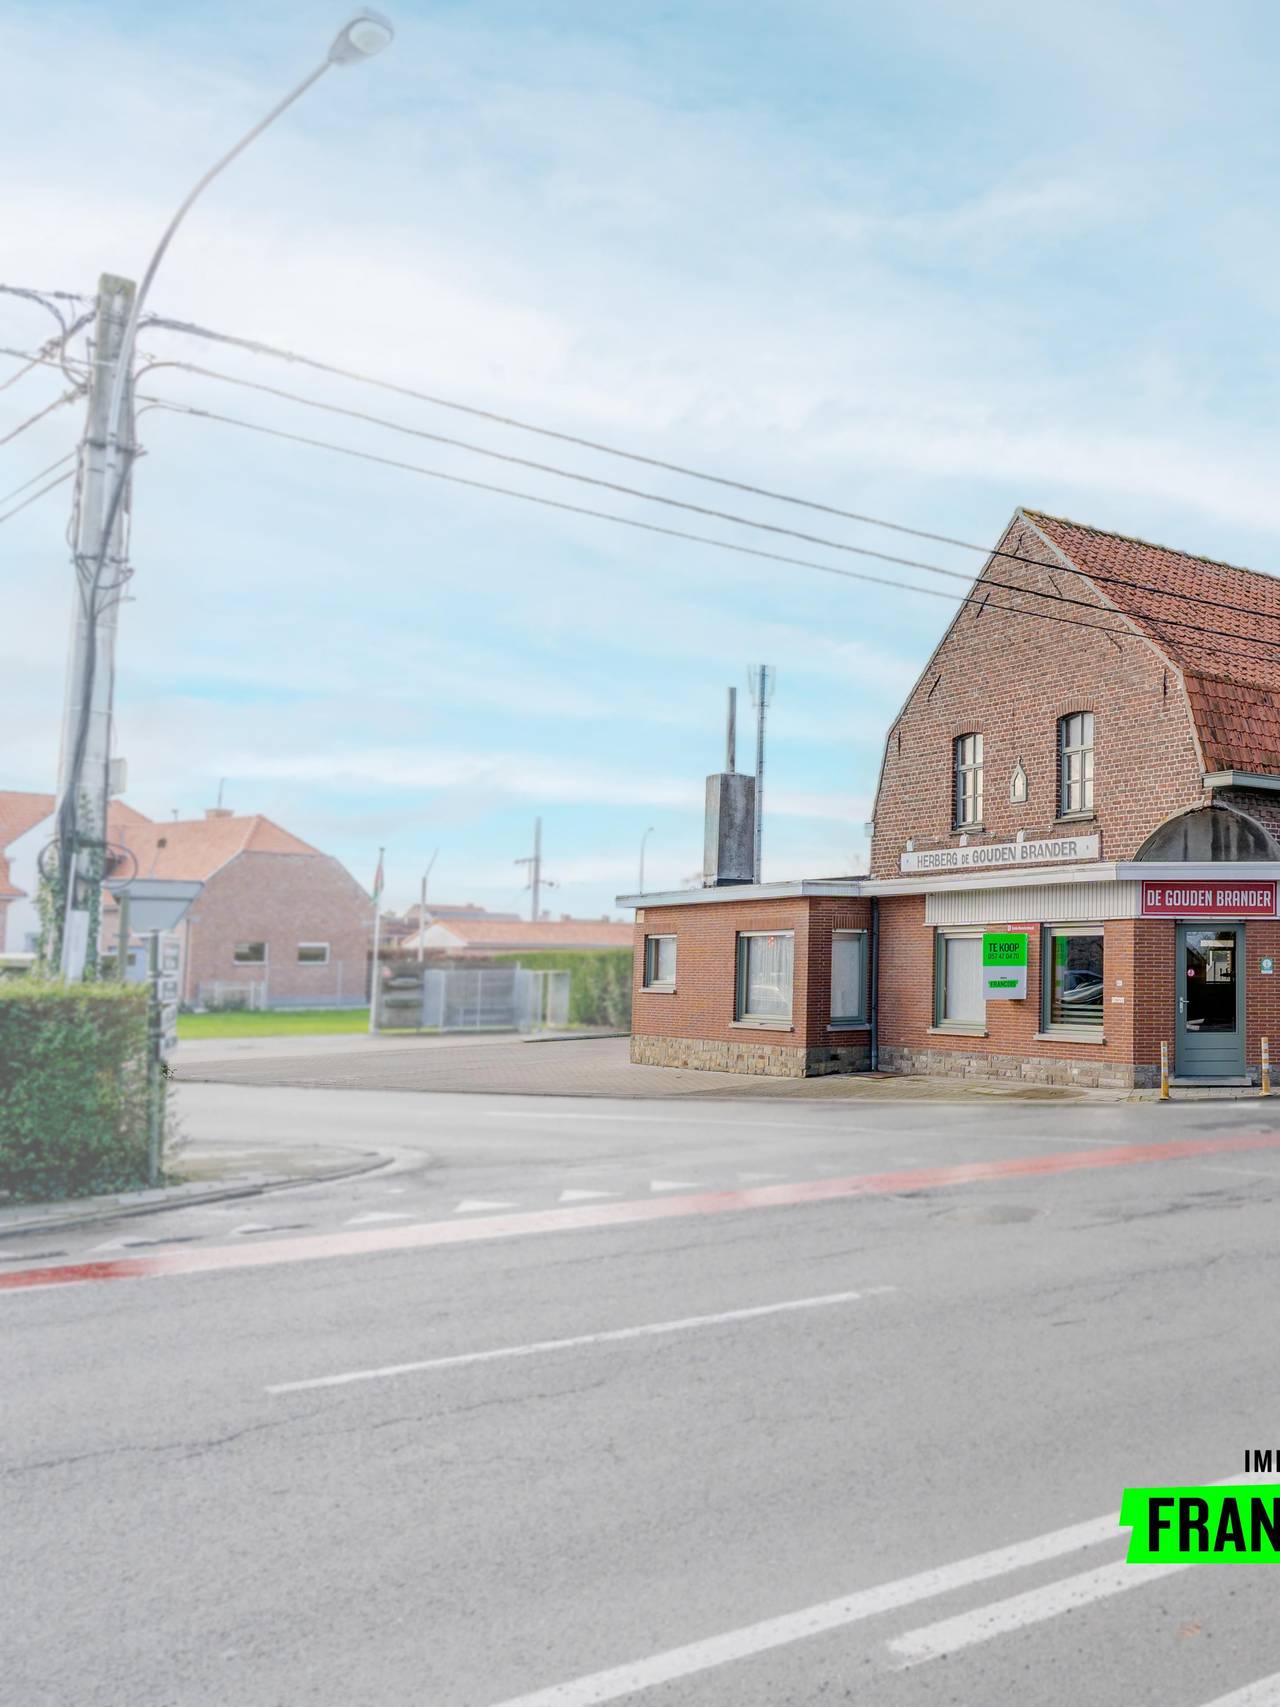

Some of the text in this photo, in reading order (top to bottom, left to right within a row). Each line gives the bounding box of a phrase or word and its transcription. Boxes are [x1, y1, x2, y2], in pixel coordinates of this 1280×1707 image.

[917, 841, 1077, 869] HERBERG DE GOUDEN BRANDER
[1147, 890, 1271, 907] DE GOUDEN BRANDER
[988, 943, 1020, 952] TE KOOP
